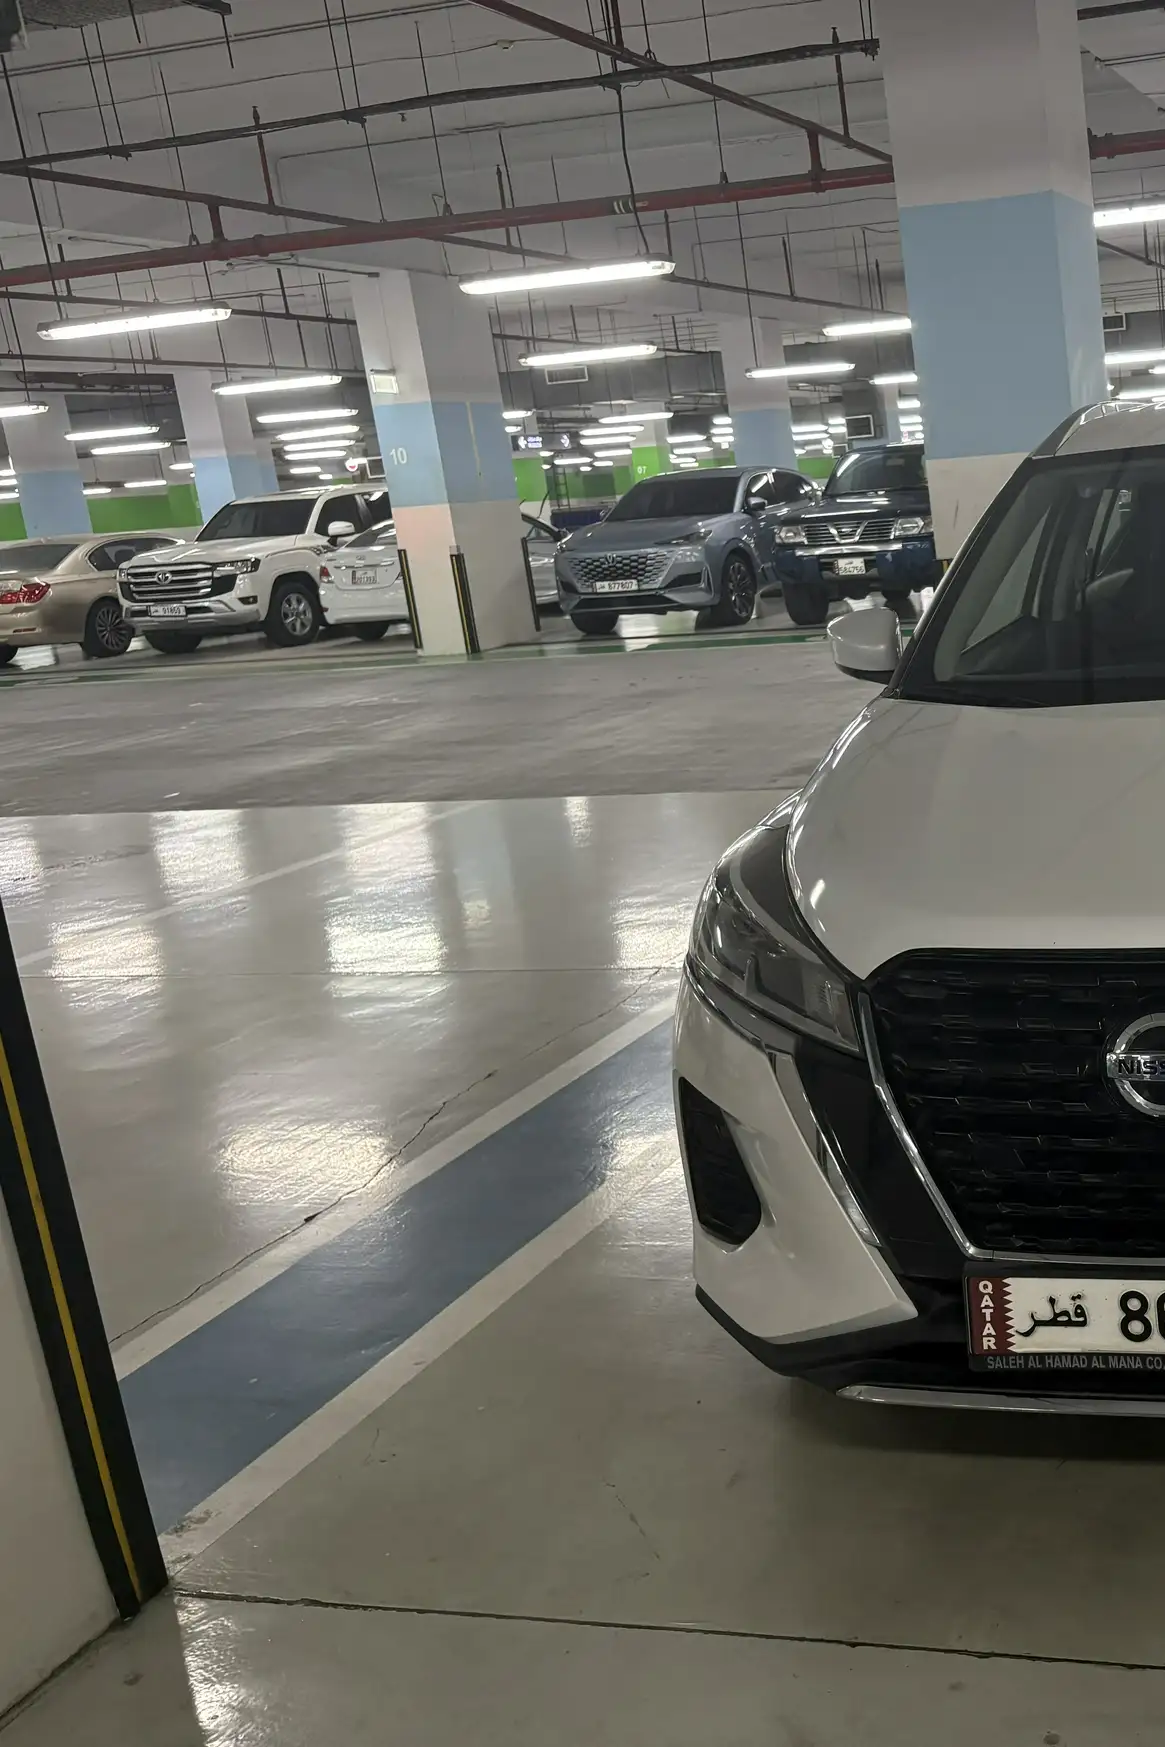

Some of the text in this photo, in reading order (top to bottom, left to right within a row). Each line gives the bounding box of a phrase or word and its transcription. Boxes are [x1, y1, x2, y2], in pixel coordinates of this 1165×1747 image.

[390, 447, 408, 465] 10
[978, 1280, 997, 1350] QATAR
[1016, 1294, 1087, 1337] قطر
[987, 1356, 1025, 1369] SALEH
[1028, 1356, 1043, 1369] AL
[1045, 1356, 1088, 1369] HAMAD
[1091, 1356, 1106, 1369] AL
[1108, 1356, 1143, 1369] MANA
